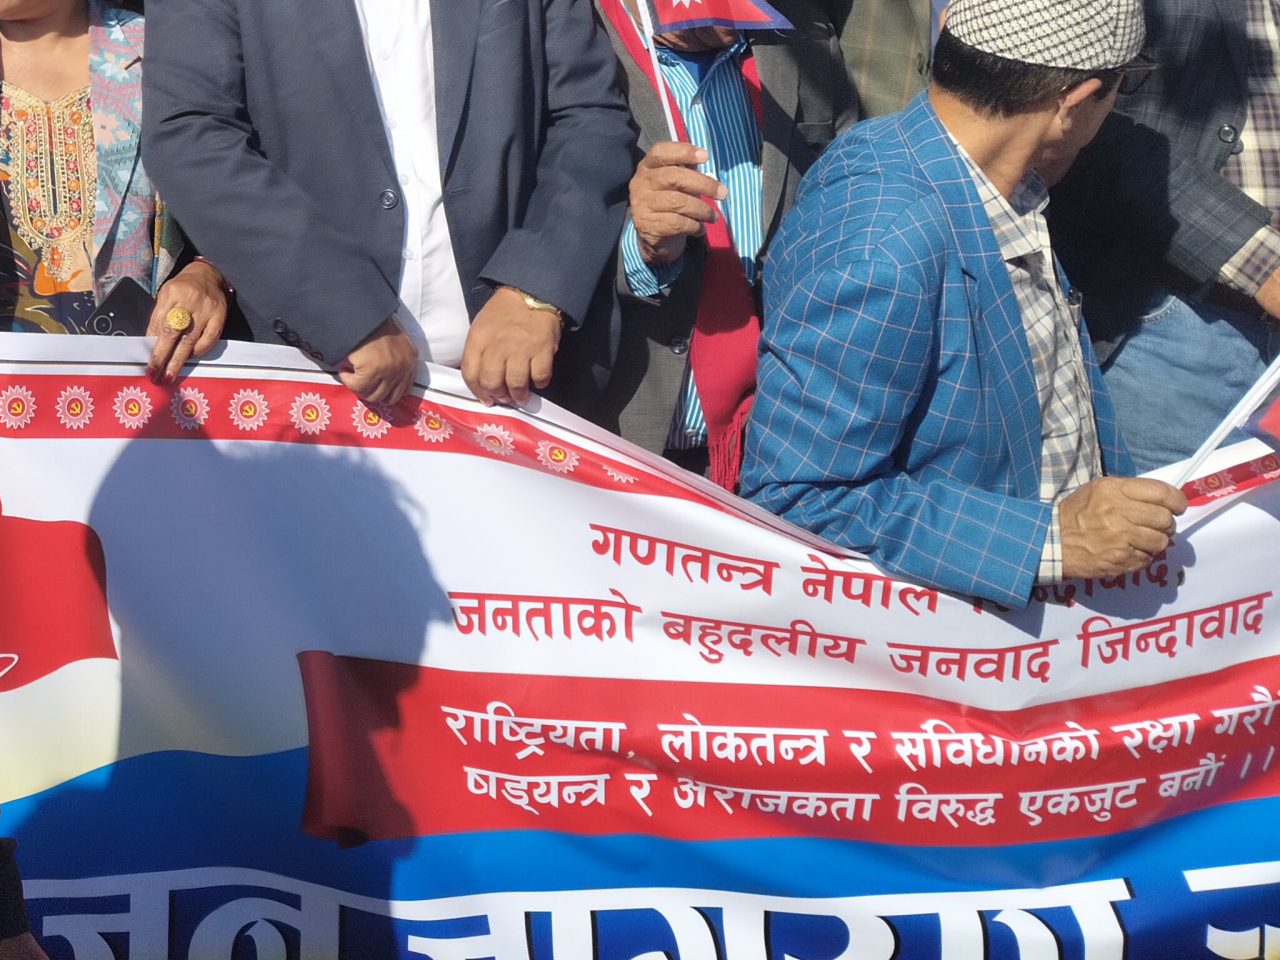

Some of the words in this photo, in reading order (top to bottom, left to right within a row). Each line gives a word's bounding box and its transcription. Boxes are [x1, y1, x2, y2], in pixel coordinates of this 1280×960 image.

[589, 523, 780, 596] गणतन्त्र
[800, 553, 938, 616] नेपाल
[447, 588, 641, 643] जनताको
[661, 611, 867, 664] बहुदलीय
[887, 639, 1059, 683] जनवाद
[1076, 591, 1273, 669] जिन्दावाद
[657, 713, 828, 765] लोकतन्त्र
[843, 730, 876, 773] र
[890, 719, 1101, 771] संविधानको
[1113, 713, 1201, 758] रक्षा
[463, 766, 611, 815] षड्यन्त्र
[624, 773, 658, 816] र
[673, 777, 880, 822] अराजकता
[896, 783, 1003, 828] विरुद्ध
[1019, 778, 1146, 824] एकजुट
[1158, 752, 1228, 799] बनौं
